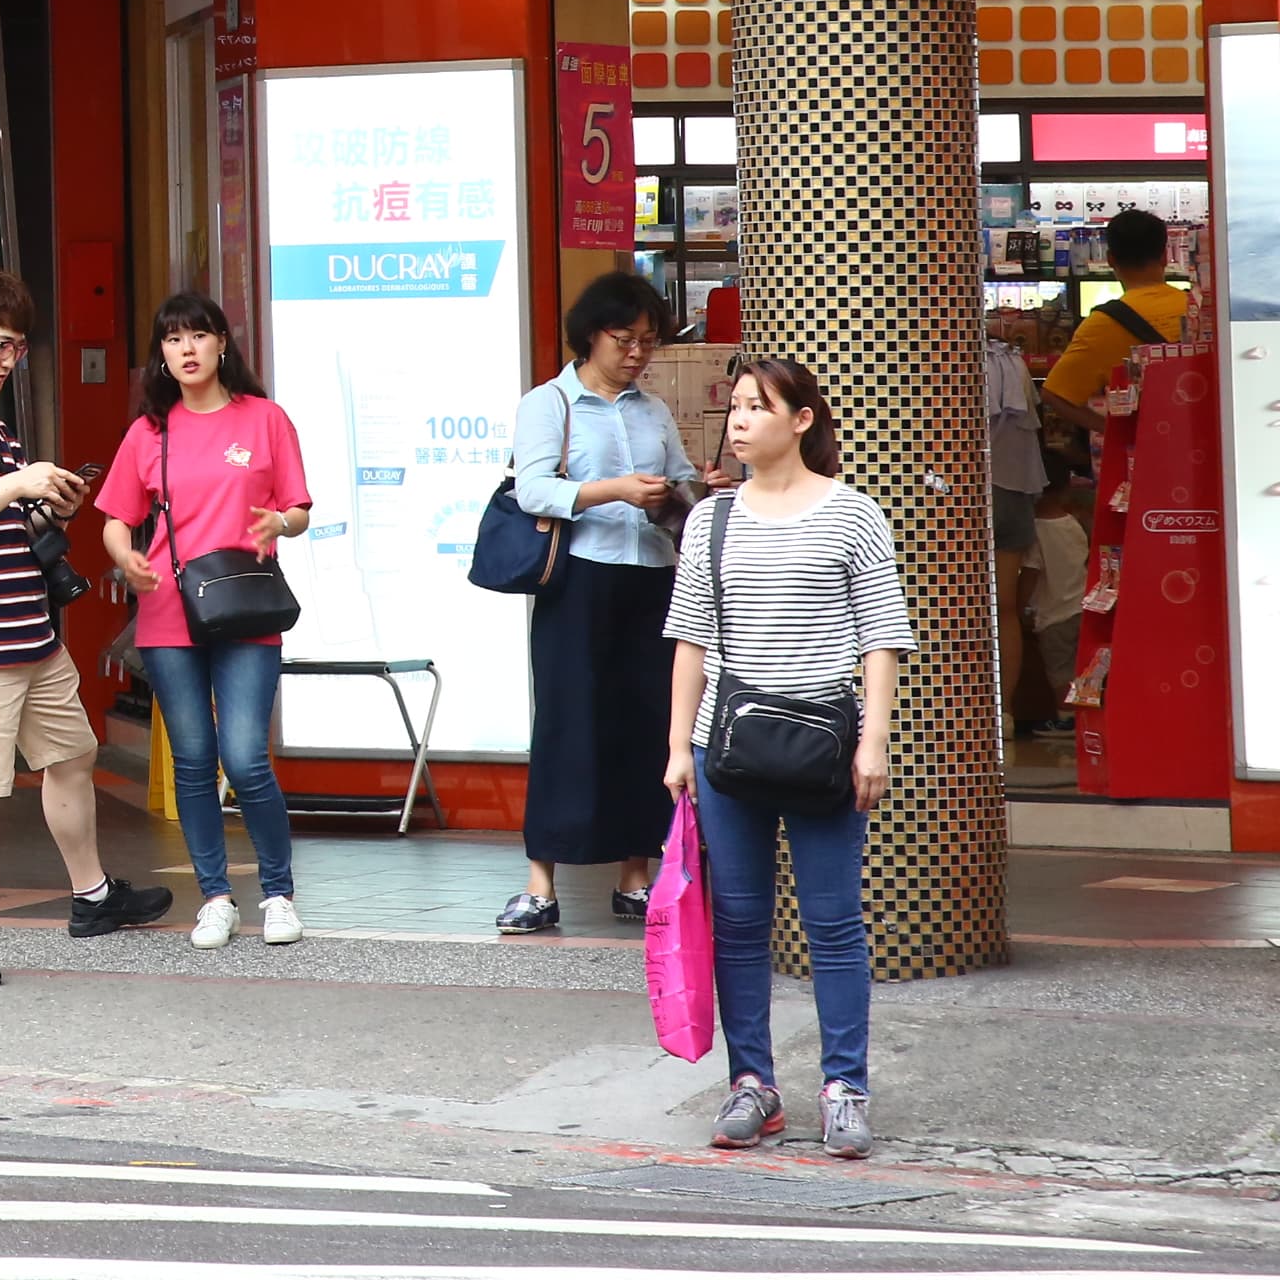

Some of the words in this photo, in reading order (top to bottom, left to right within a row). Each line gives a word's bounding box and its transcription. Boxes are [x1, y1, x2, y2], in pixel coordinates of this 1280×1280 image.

[581, 103, 614, 184] 5
[332, 179, 496, 223] 抗痘有感
[328, 253, 454, 282] DUCRAY
[362, 470, 402, 482] DUCRAY
[314, 524, 344, 538] DUCRAY
